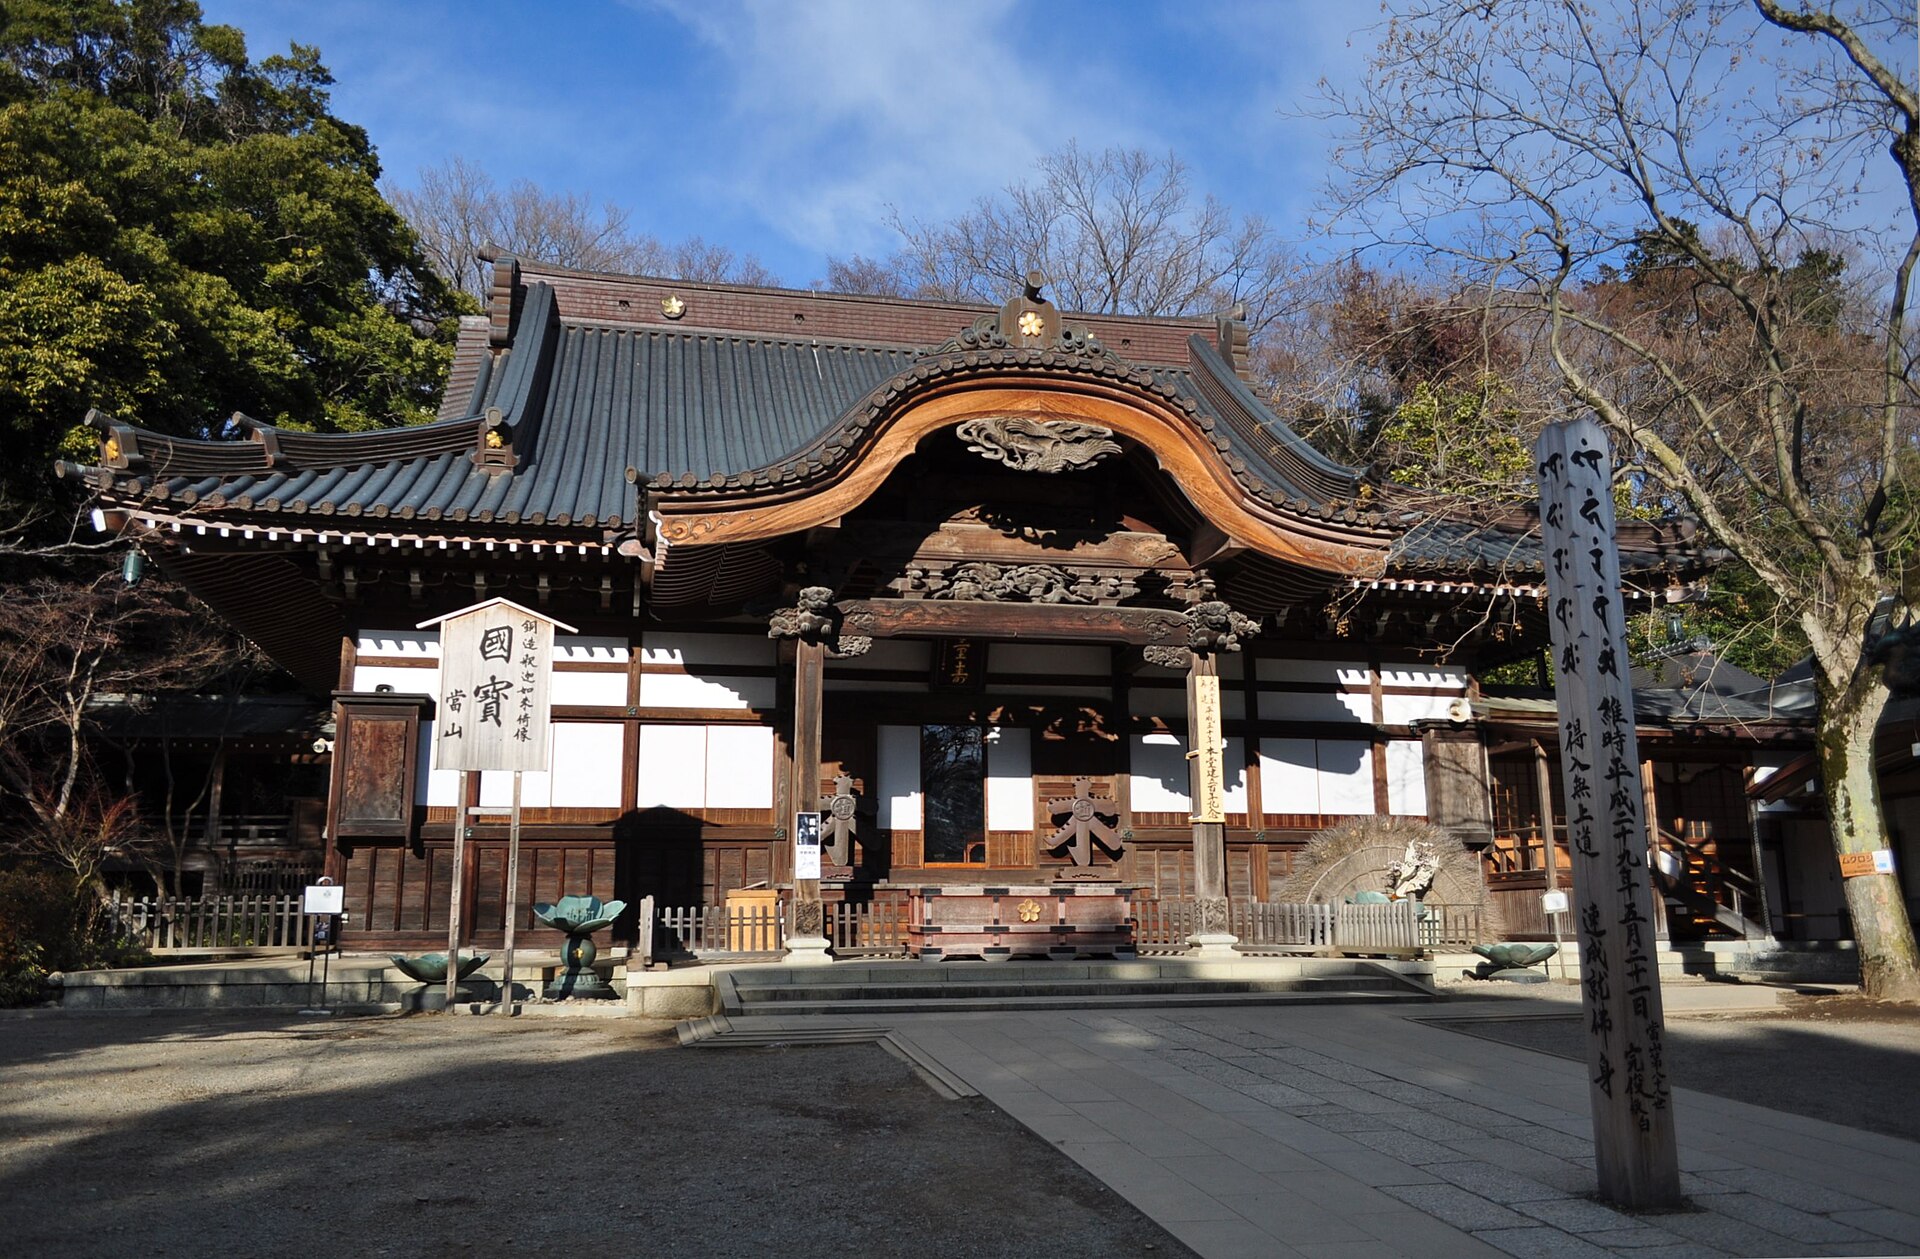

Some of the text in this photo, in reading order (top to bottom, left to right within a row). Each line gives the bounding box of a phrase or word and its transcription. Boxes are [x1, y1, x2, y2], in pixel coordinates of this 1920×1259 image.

[444, 688, 467, 739] 當山
[1565, 718, 1600, 858] 得入無上道
